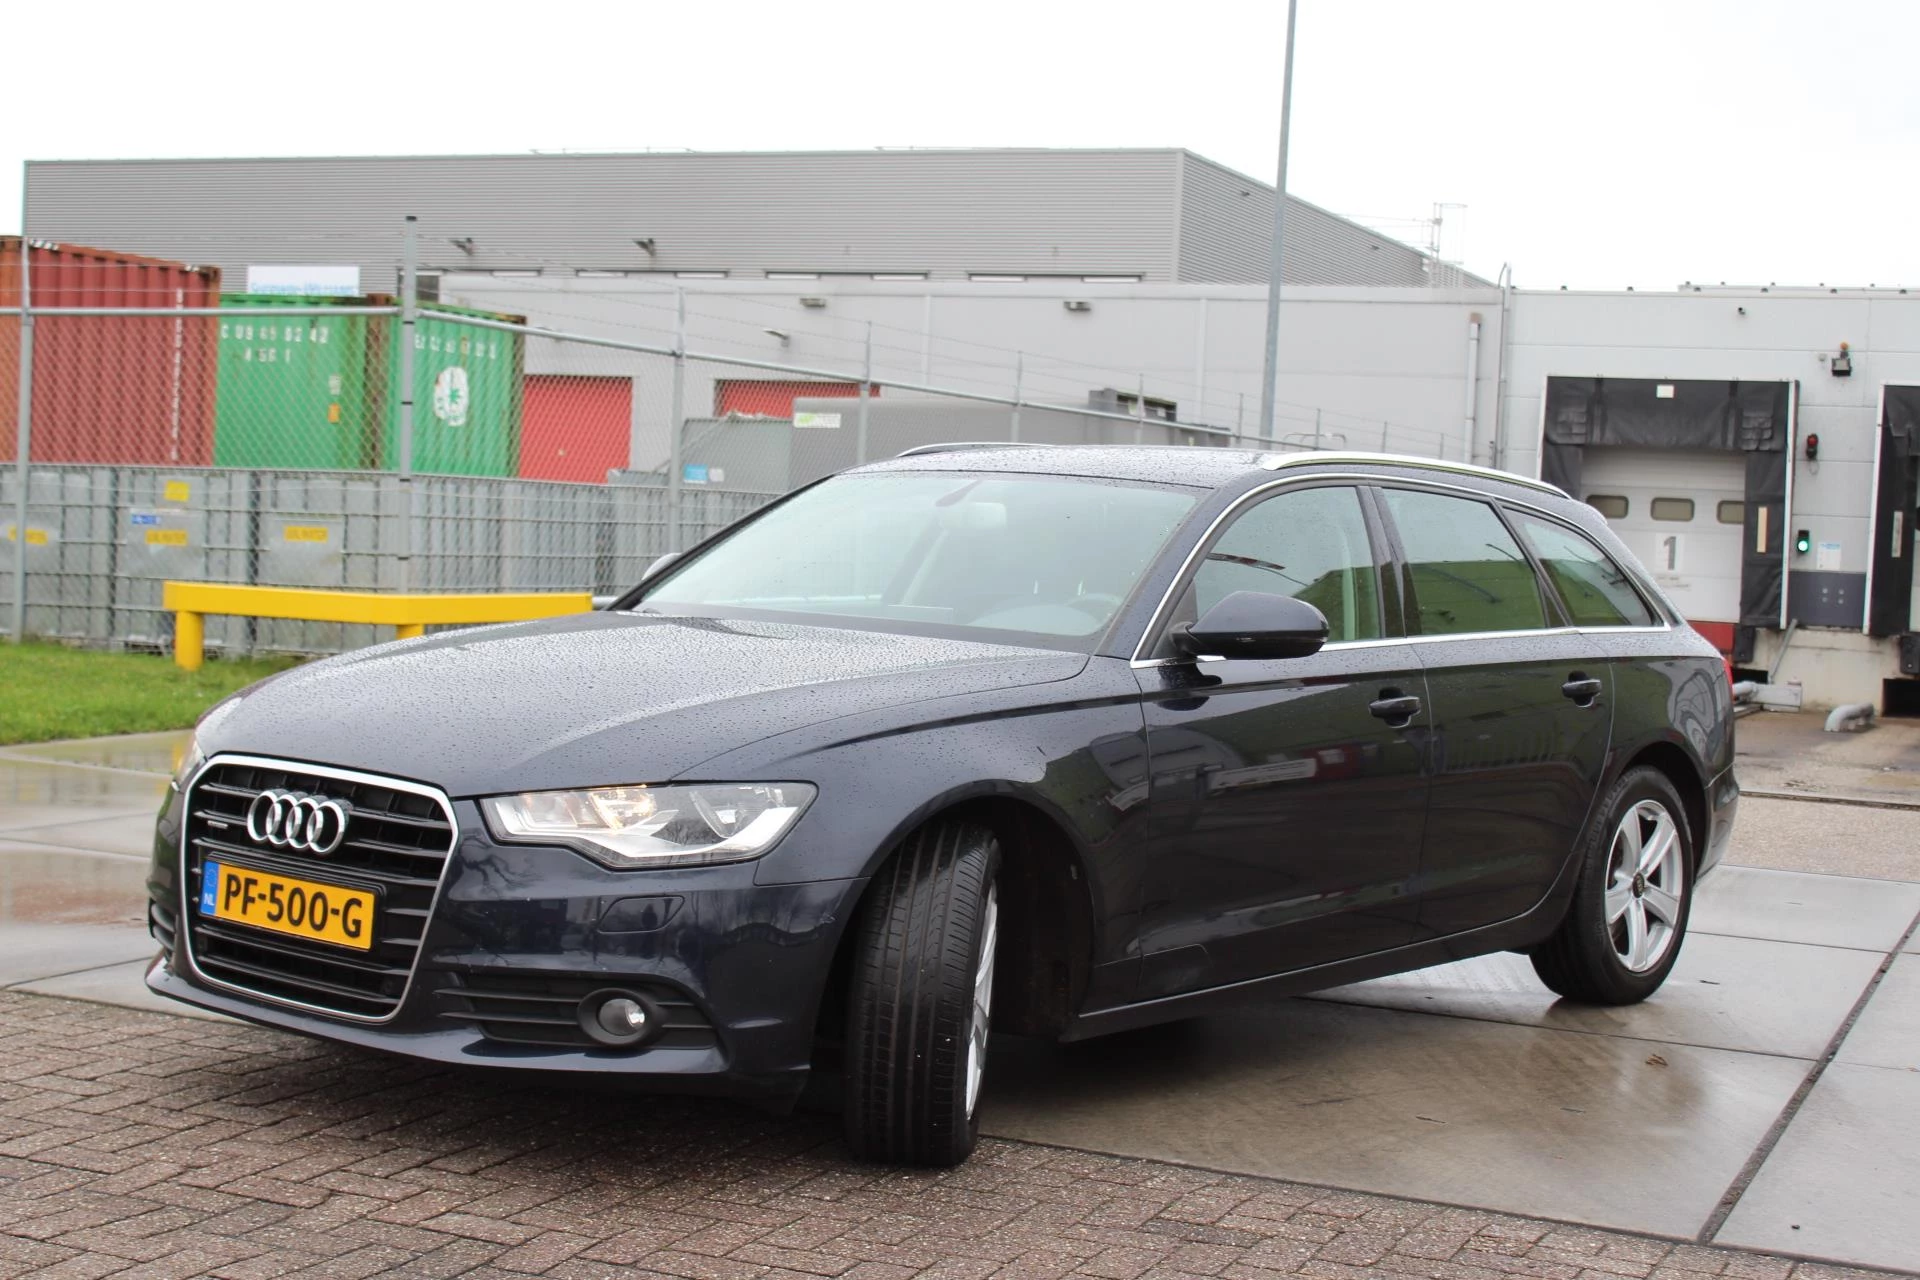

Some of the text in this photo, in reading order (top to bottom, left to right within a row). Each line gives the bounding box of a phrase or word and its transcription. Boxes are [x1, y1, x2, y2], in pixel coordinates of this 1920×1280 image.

[1663, 536, 1677, 571] 1
[203, 892, 216, 907] NL
[223, 873, 363, 939] PF-500-G
